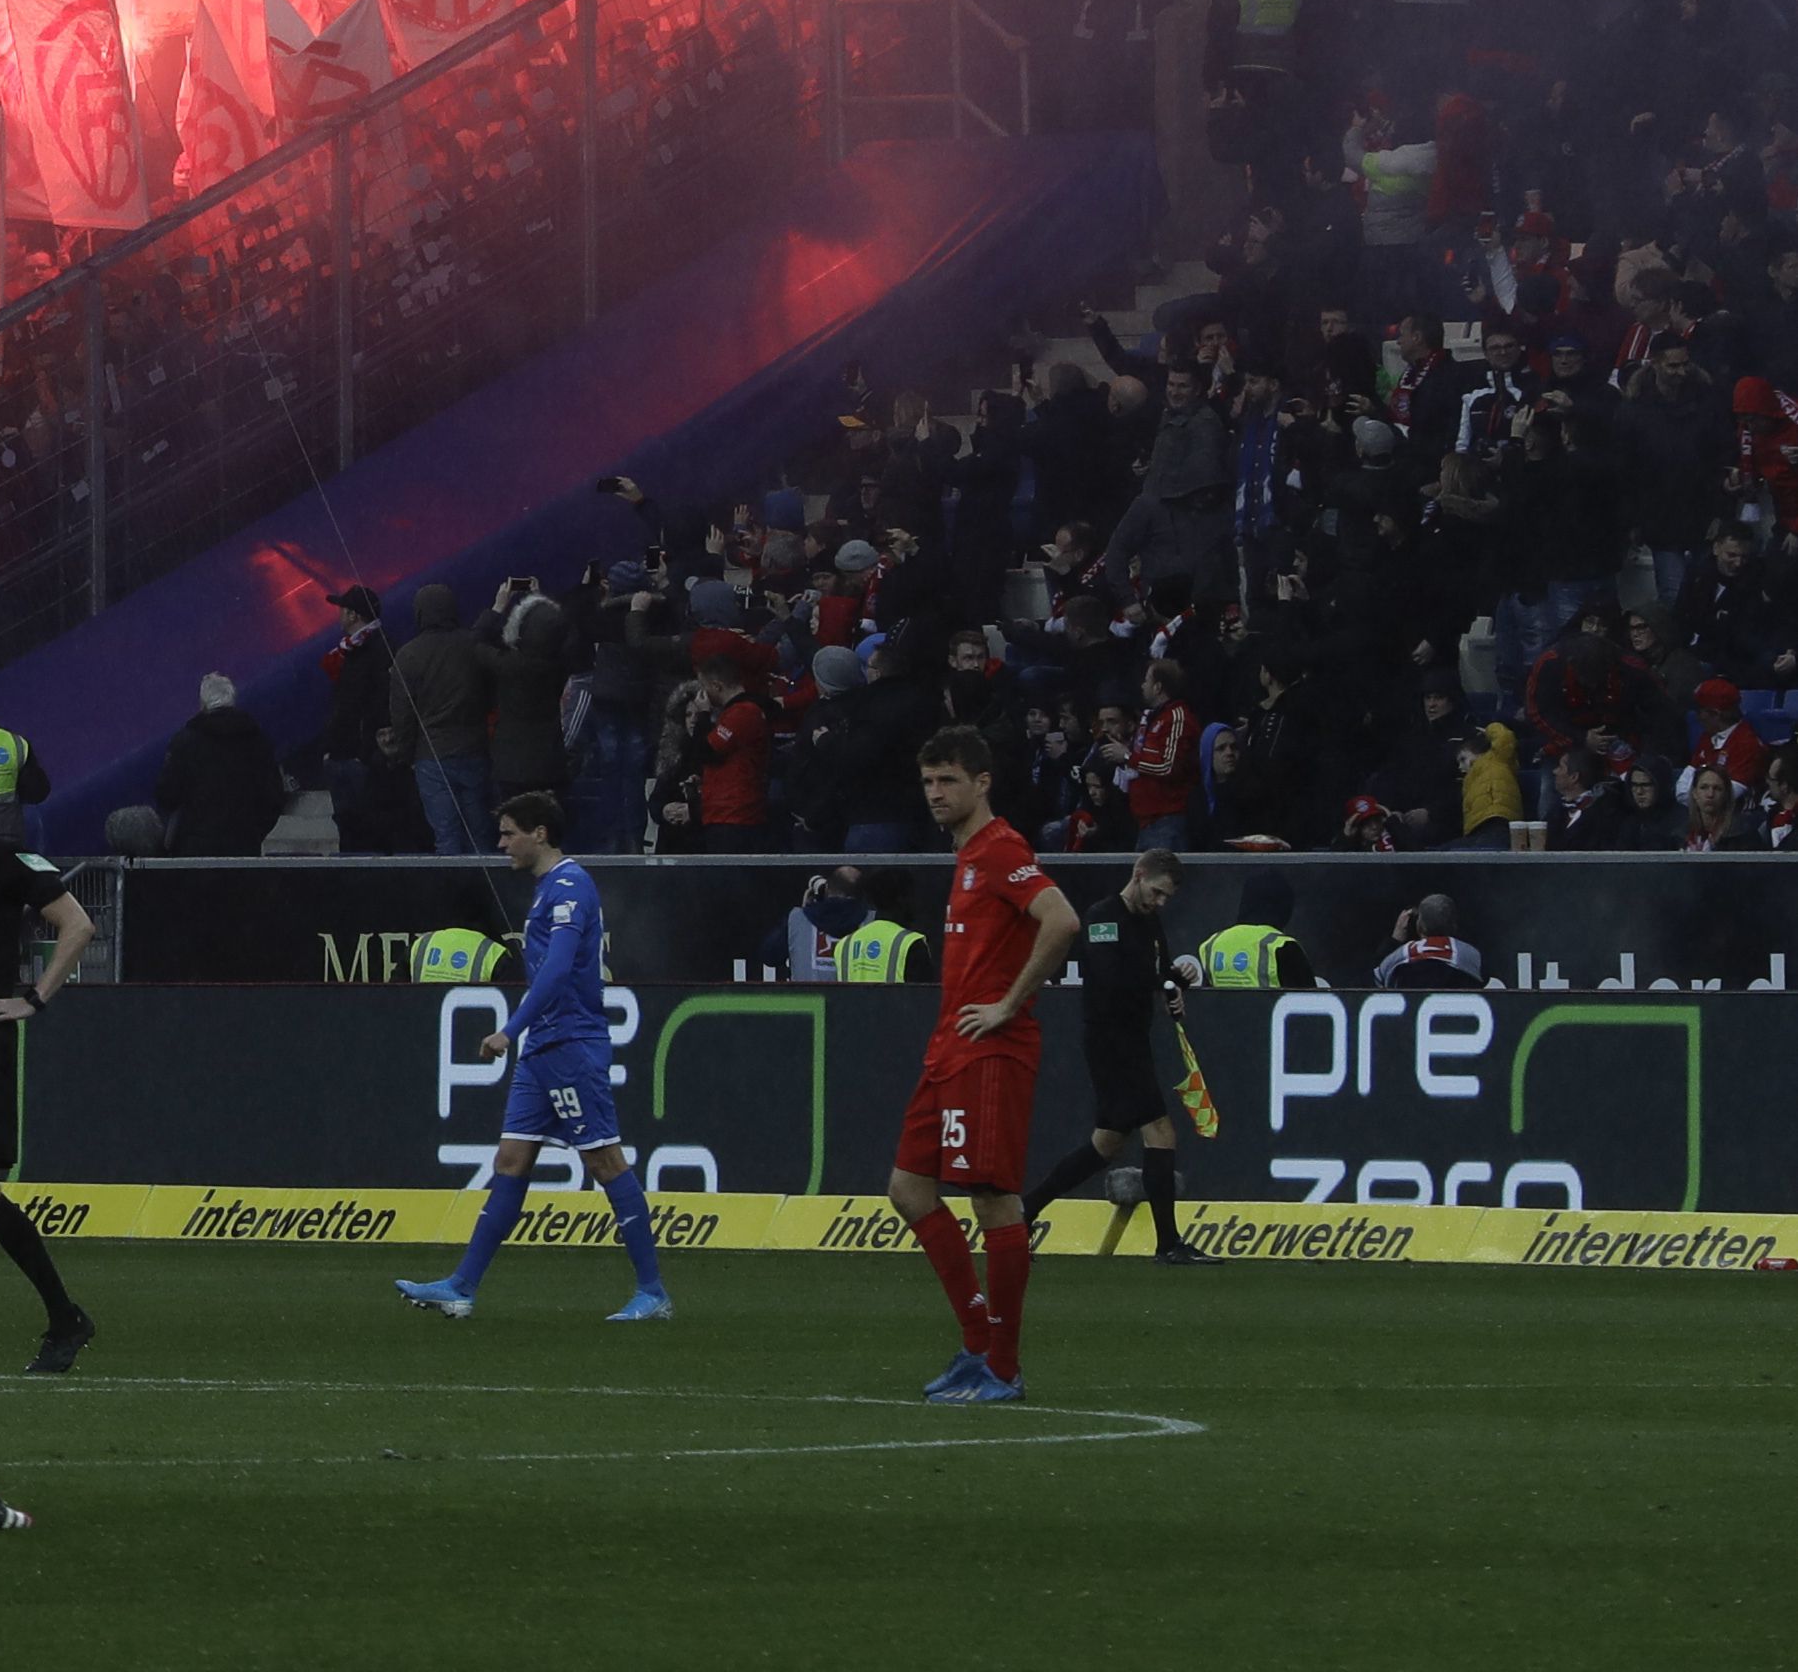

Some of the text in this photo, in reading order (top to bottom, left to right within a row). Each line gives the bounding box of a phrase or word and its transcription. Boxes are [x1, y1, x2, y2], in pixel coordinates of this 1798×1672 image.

[1269, 992, 1496, 1134] pre
[548, 1087, 582, 1120] 29
[941, 1109, 966, 1148] 25
[182, 1188, 397, 1241] interwetten
[1179, 1210, 1414, 1259] interwetten
[1524, 1212, 1777, 1269] interwetten
